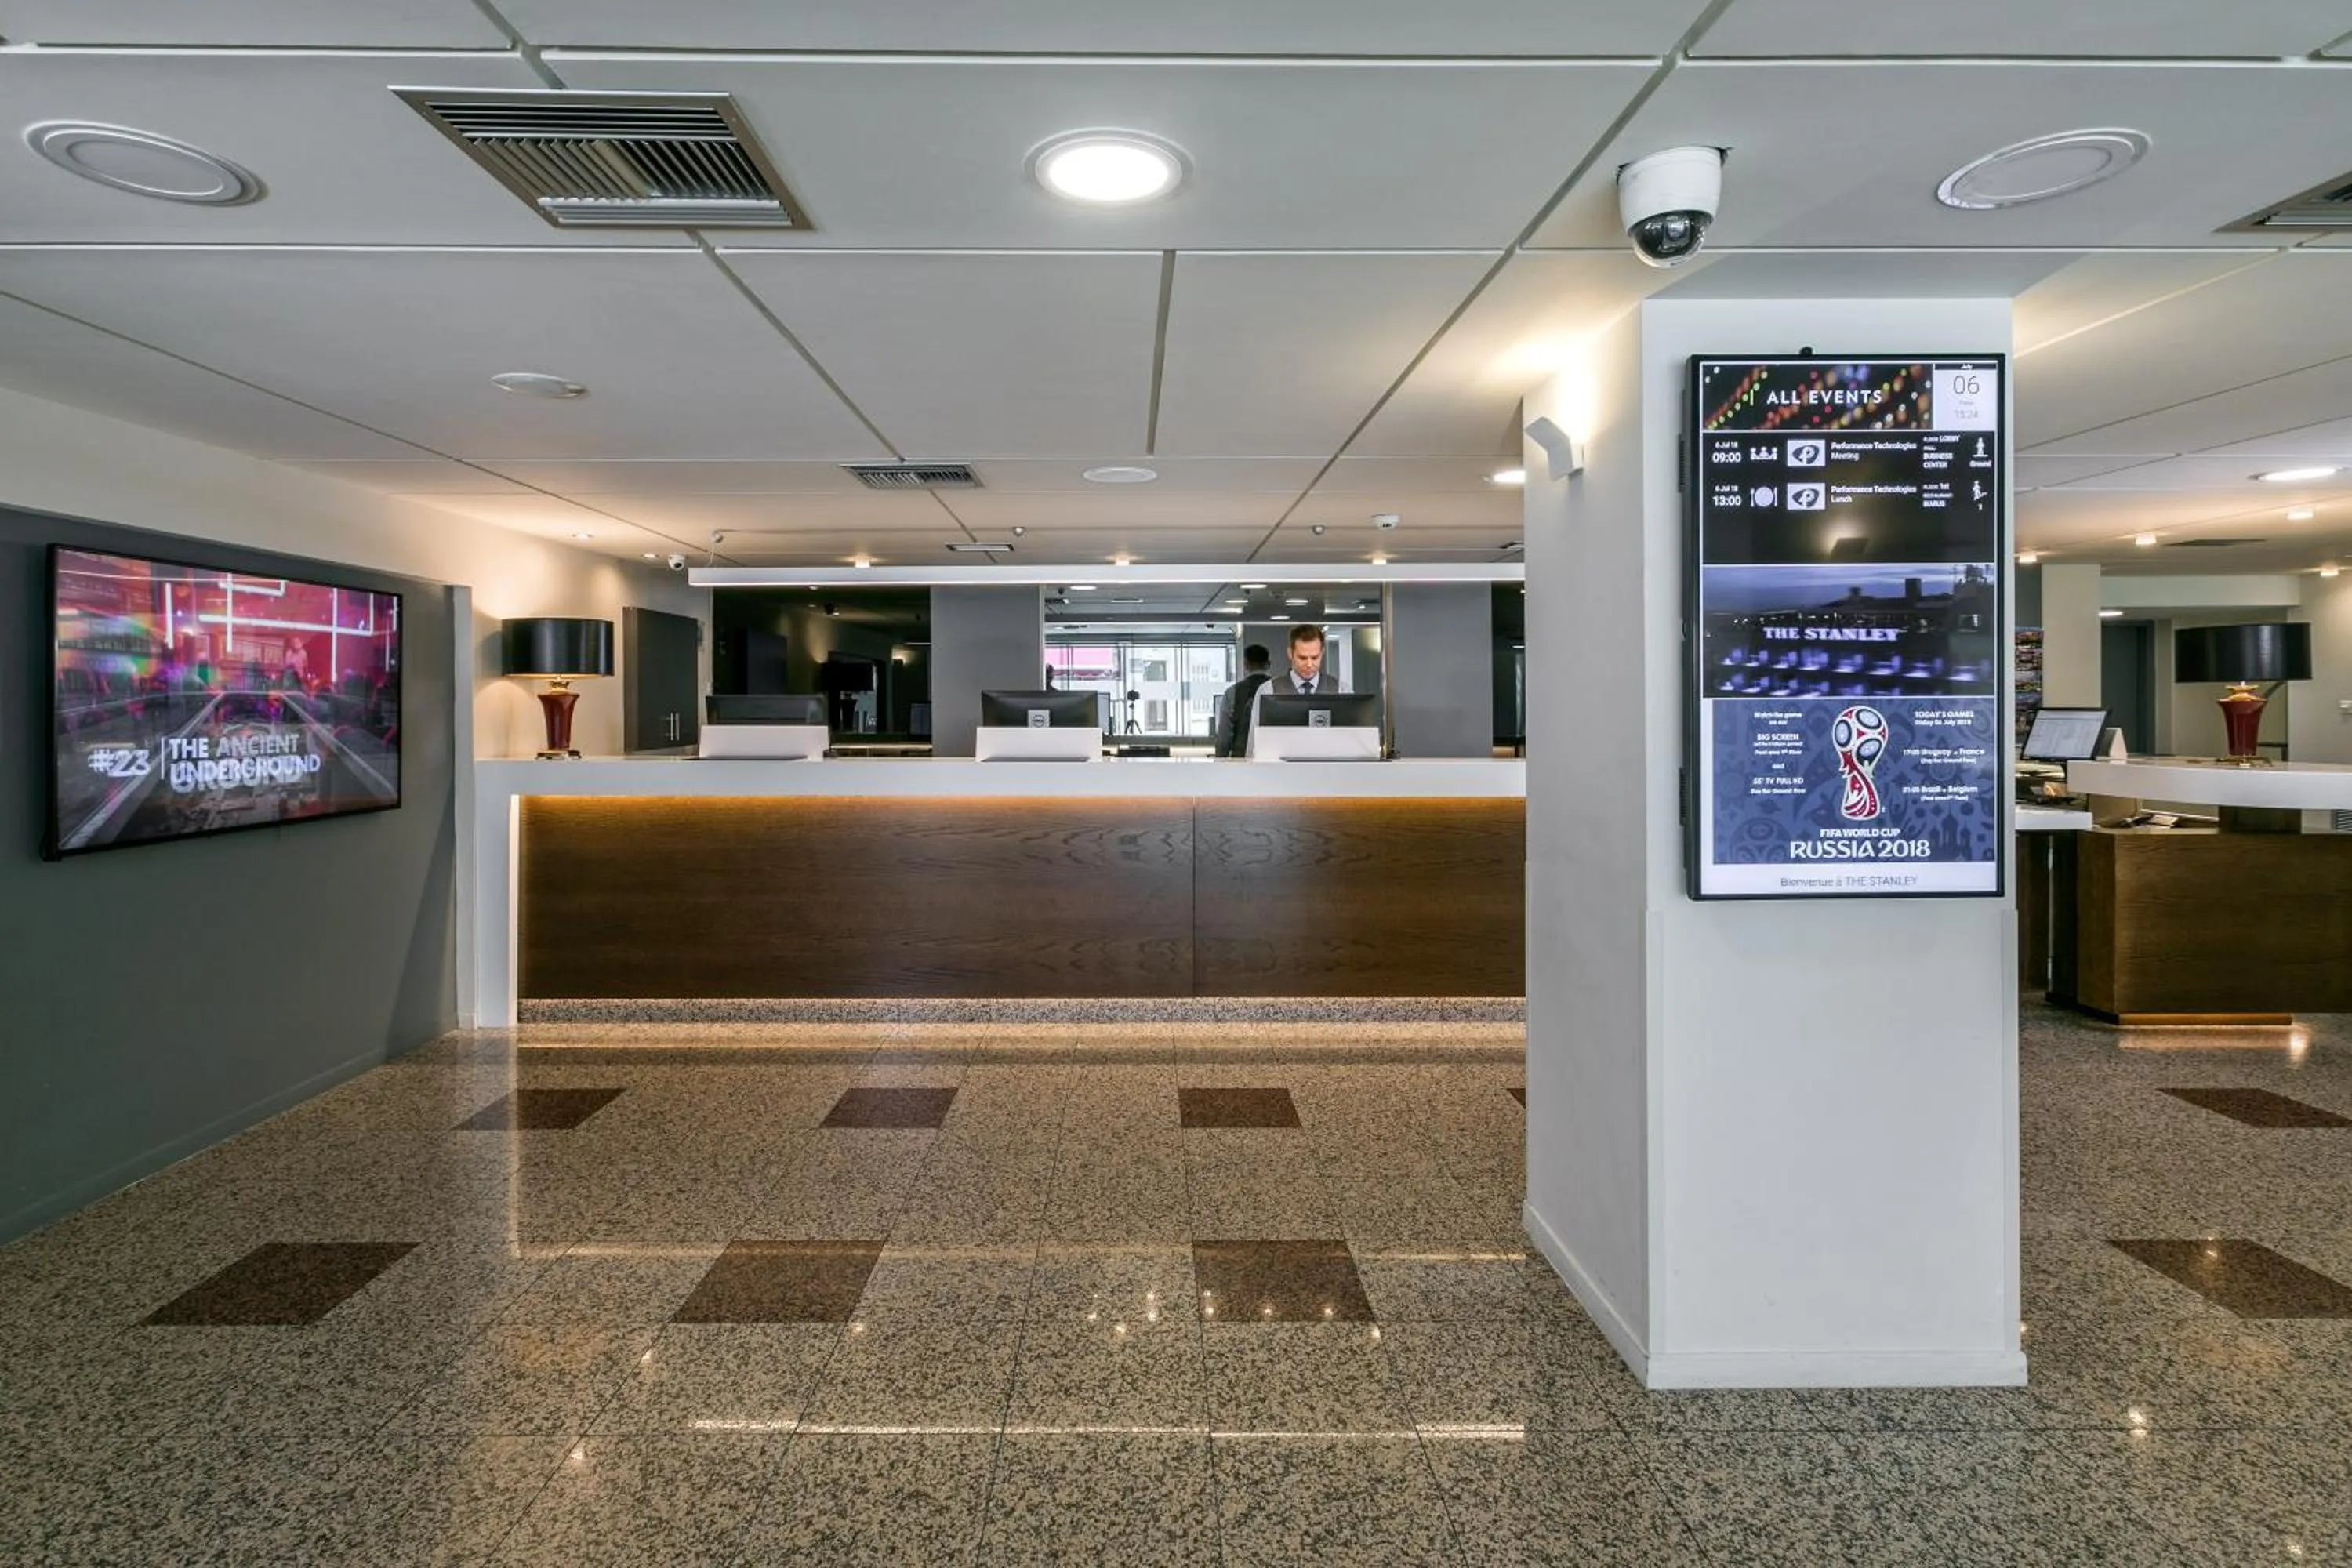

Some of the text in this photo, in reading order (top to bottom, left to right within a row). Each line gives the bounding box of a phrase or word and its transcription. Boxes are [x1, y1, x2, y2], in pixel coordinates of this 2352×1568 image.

[1953, 376, 1980, 394] 06
[1766, 390, 1882, 405] ALL EVENTS
[1874, 441, 1917, 451] Technologies
[1712, 452, 1741, 463] 09:00
[1831, 452, 1860, 462] Meeting
[1874, 485, 1917, 495] Technologies
[1713, 495, 1742, 506] 13:00
[1763, 627, 1900, 641] THE STANLEY
[1914, 710, 1946, 718] TODAY'S
[169, 734, 300, 760] THE ANCIENT
[170, 753, 321, 788] UNDERGROUND
[1820, 828, 1901, 837] FIFA WORLD CUP
[1790, 840, 1931, 858] RUSSIA 2018
[1780, 877, 1833, 887] Bienvenue
[1845, 876, 1867, 886] THE
[1869, 876, 1918, 887] STANLEY
